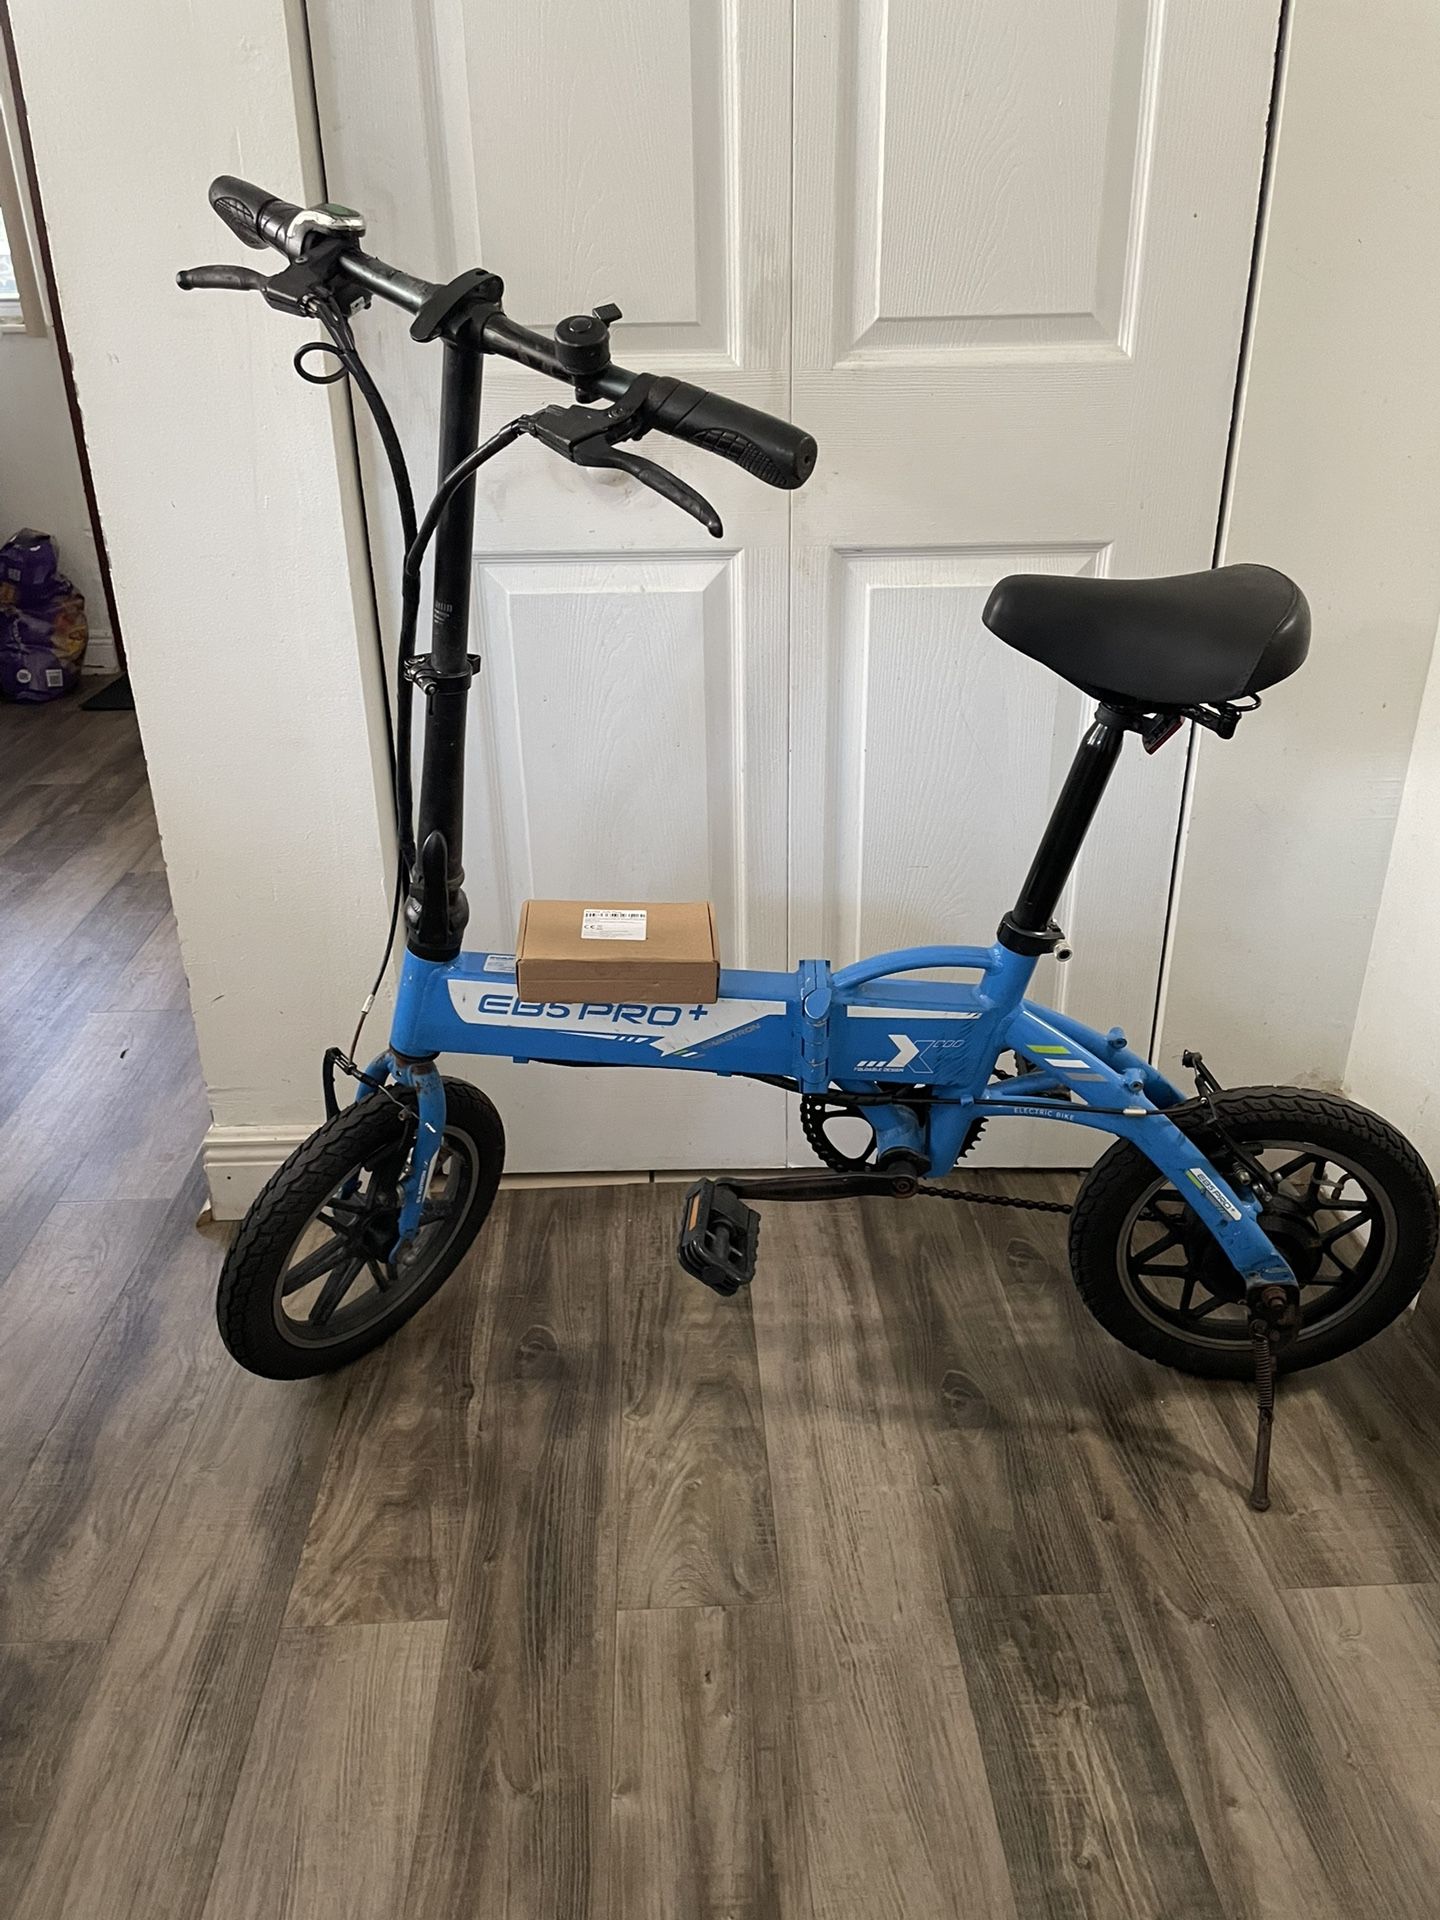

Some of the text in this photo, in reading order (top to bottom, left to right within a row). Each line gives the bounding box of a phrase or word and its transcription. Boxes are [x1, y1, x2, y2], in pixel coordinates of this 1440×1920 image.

[478, 993, 571, 1019] EB5
[1014, 1107, 1076, 1121] ELECTRIC BIKE
